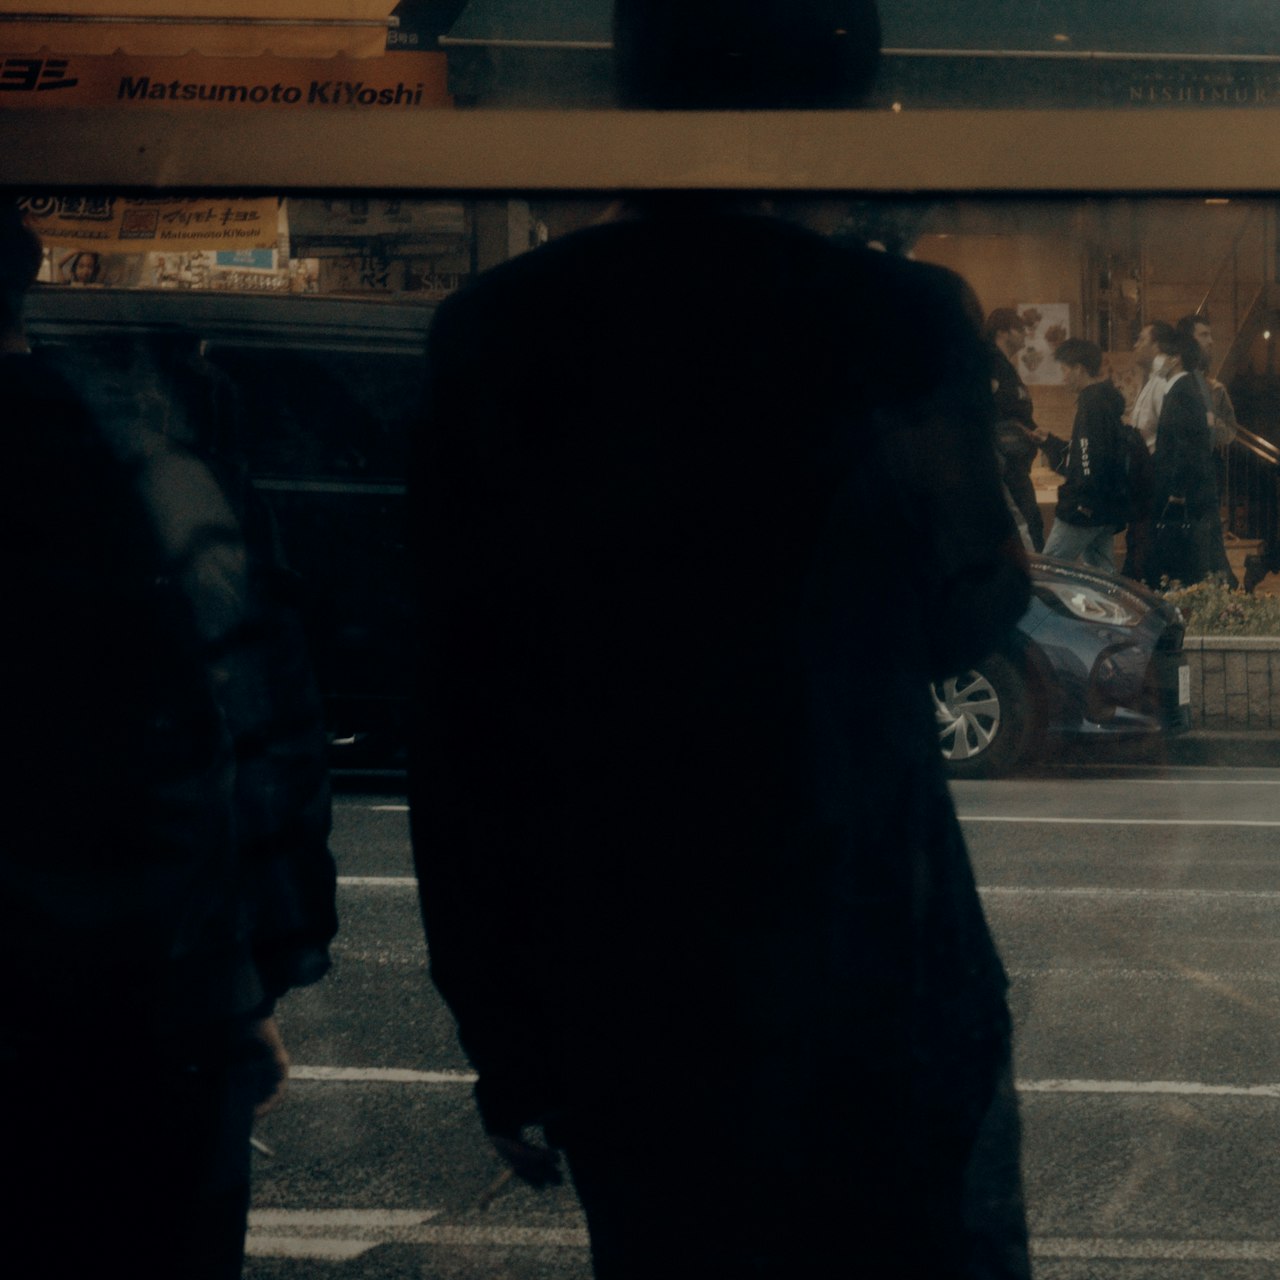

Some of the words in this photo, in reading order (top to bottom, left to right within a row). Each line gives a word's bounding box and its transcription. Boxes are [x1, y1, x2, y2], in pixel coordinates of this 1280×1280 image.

[0, 58, 78, 91] ヨシ
[117, 76, 303, 104] Matsumoto
[307, 79, 425, 106] KiYoshi
[160, 229, 222, 240] Matsumoto
